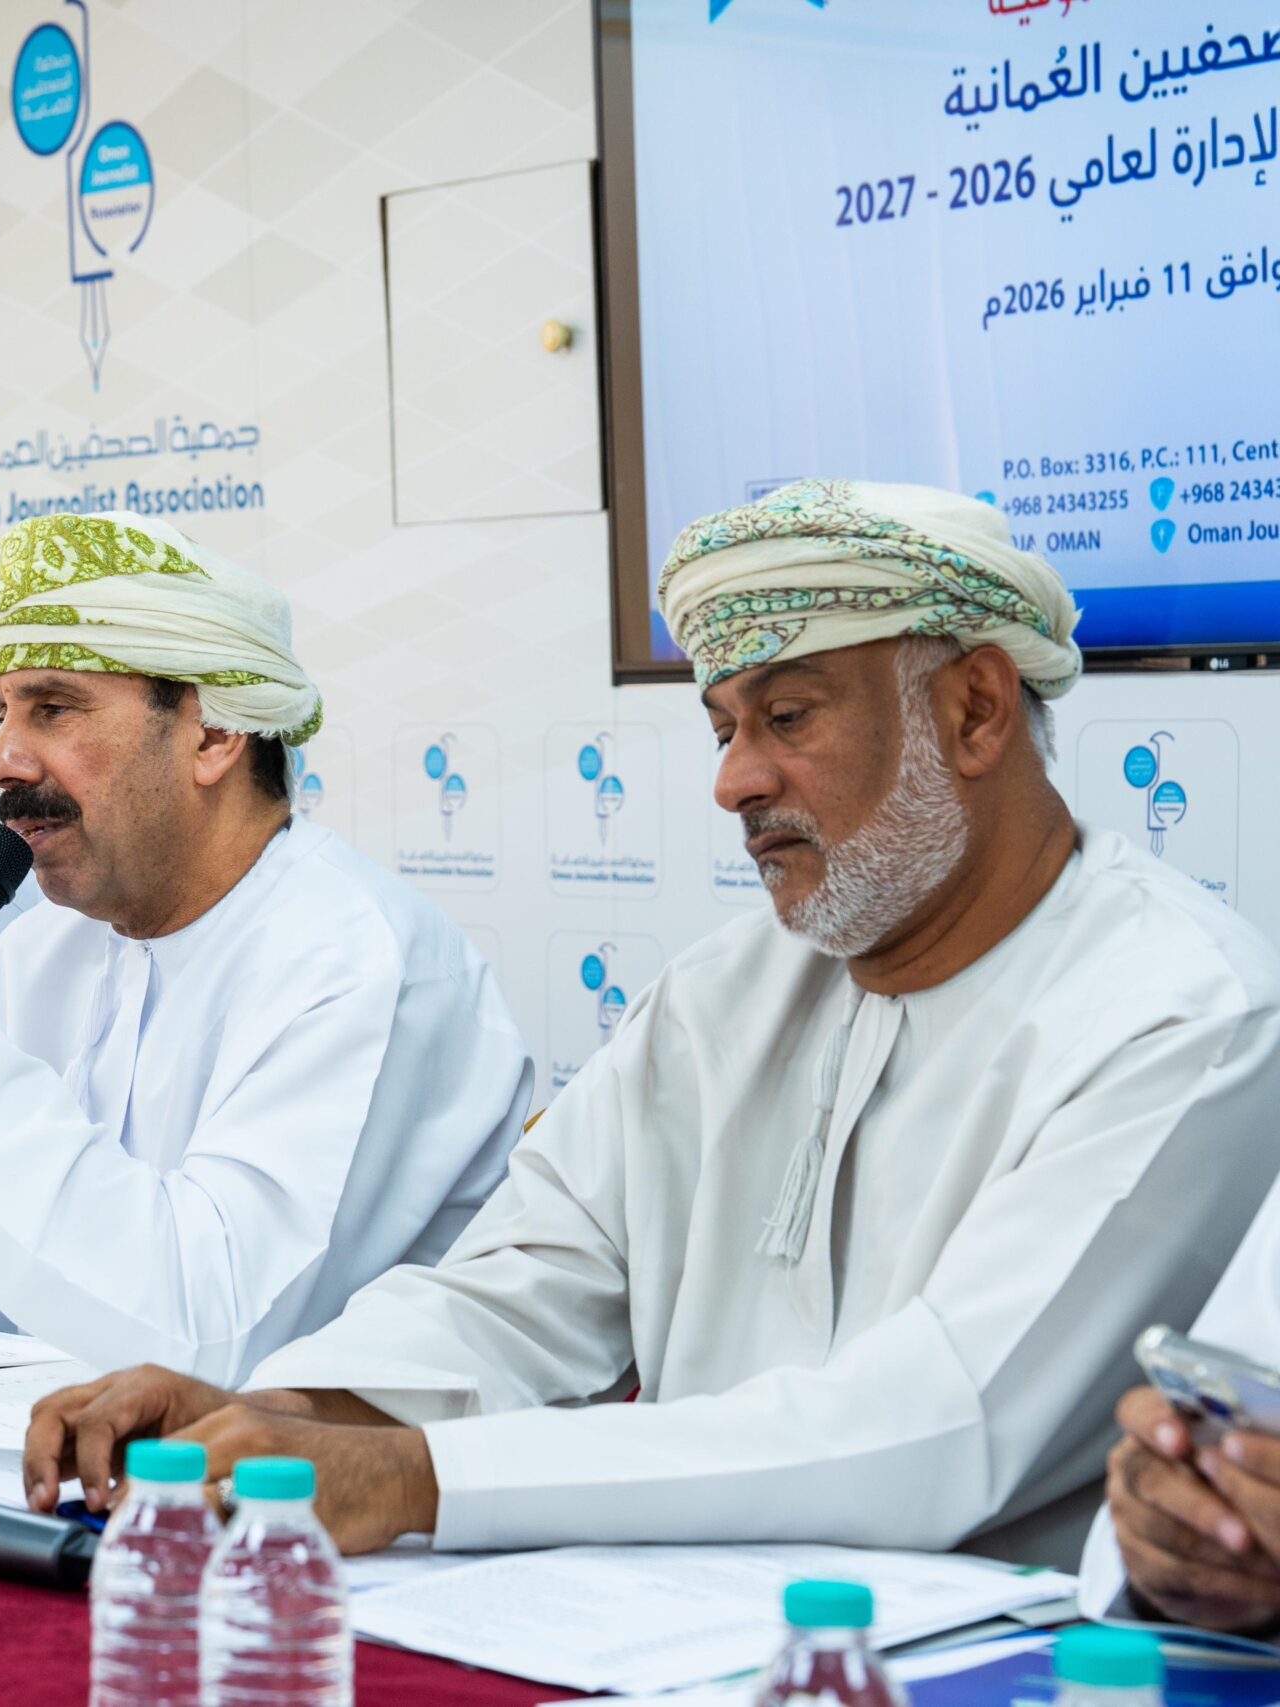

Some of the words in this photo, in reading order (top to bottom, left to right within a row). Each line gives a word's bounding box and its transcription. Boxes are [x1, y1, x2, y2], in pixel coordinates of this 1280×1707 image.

[949, 154, 1036, 210] 2026
[1049, 126, 1156, 222] لعامي
[835, 174, 916, 228] 2027
[1074, 265, 1151, 316] فبراير
[1163, 261, 1191, 295] 11
[171, 414, 261, 459] جمعية
[1003, 458, 1036, 480] P.O.
[1040, 456, 1080, 478] Box:
[1084, 450, 1136, 474] 3316,
[1186, 443, 1227, 467] 111,
[1232, 438, 1279, 463] Cent
[125, 473, 264, 515] Association
[1002, 495, 1042, 517] +968
[1046, 488, 1130, 514] 24343255
[1180, 481, 1225, 505] +968
[1187, 522, 1243, 545] Oman
[1247, 519, 1279, 542] Jou
